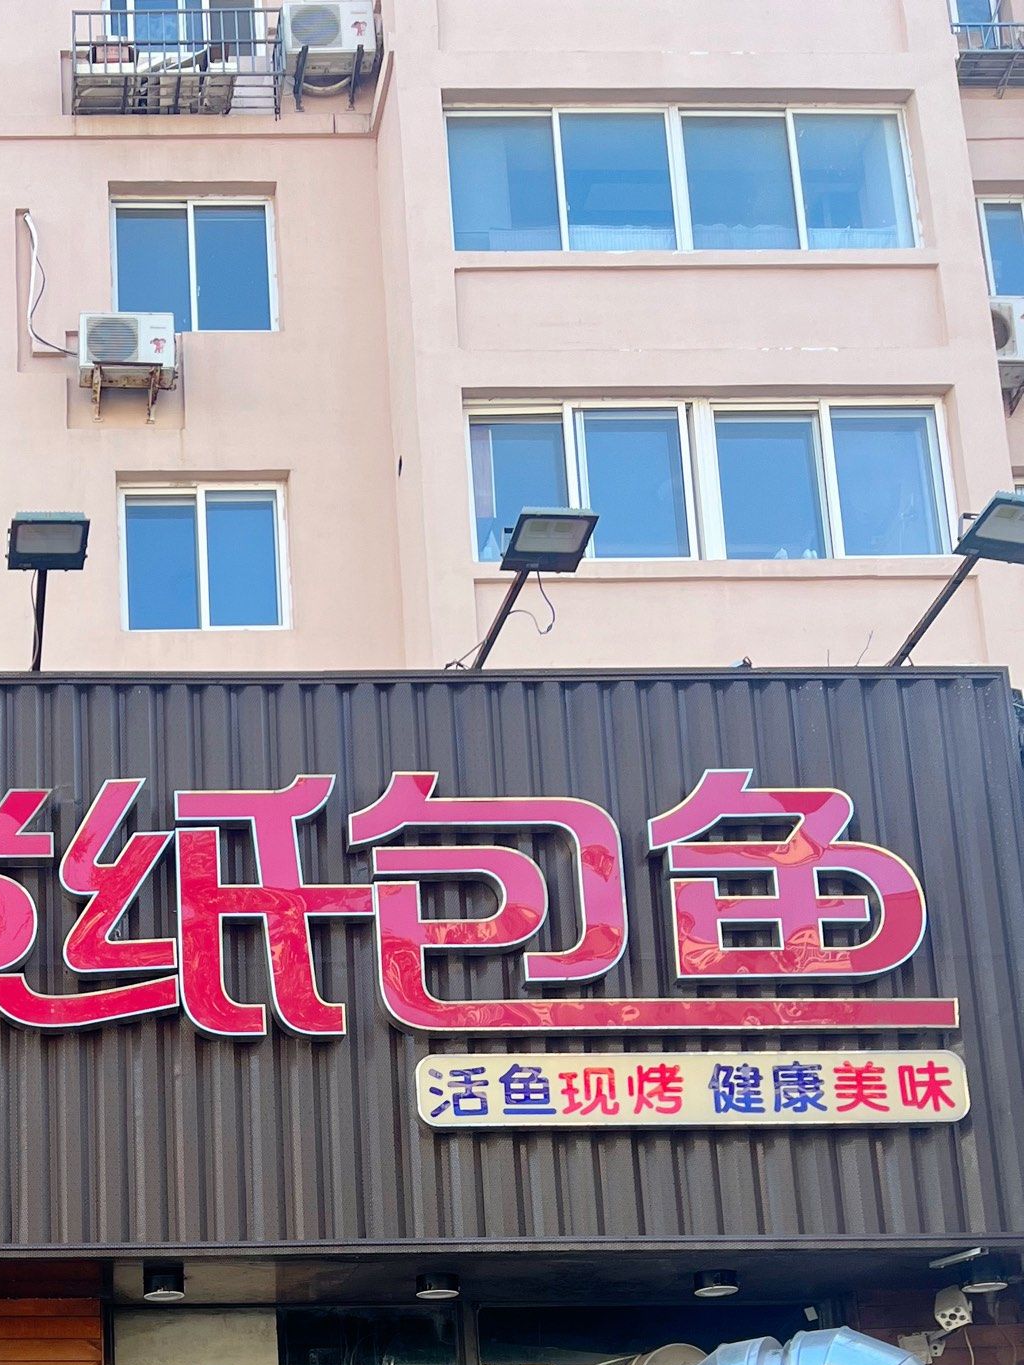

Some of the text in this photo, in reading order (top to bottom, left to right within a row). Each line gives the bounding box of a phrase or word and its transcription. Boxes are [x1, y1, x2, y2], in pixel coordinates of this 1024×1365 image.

[428, 1060, 957, 1118] 活鱼现烤 健康美味
